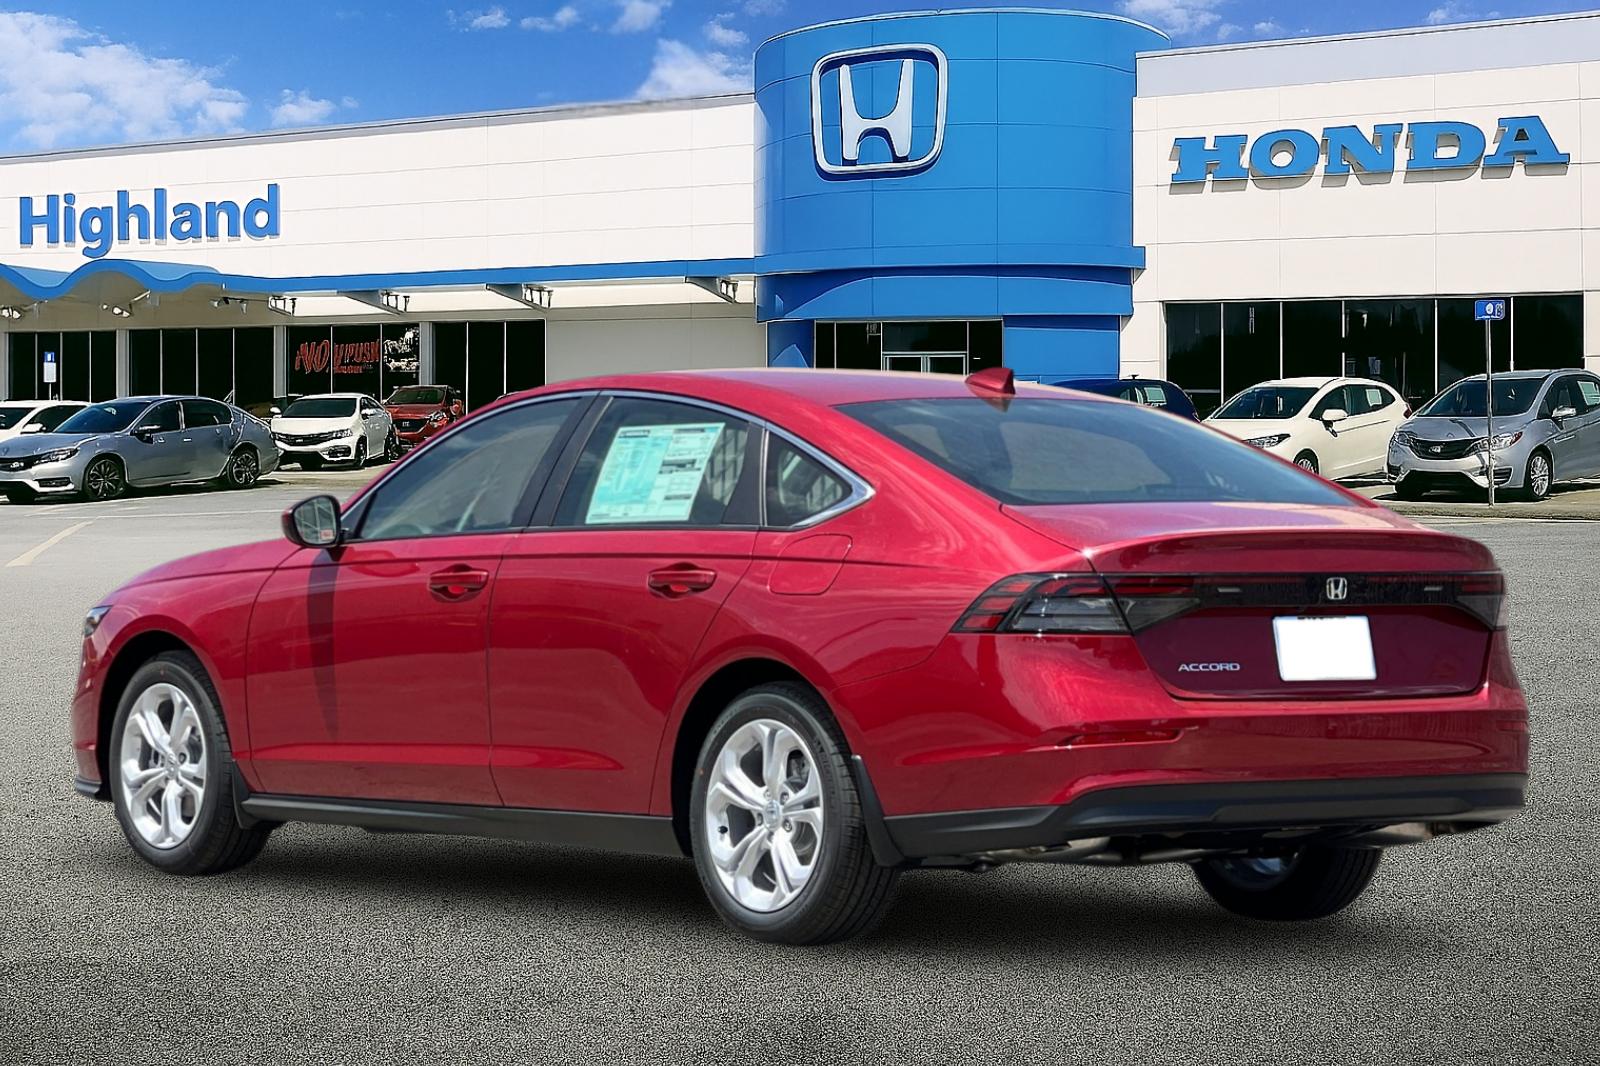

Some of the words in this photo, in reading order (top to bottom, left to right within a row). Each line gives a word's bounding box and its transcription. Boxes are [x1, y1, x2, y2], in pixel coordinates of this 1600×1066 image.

[1170, 114, 1570, 188] HONDA
[19, 183, 281, 258] Highland
[1178, 663, 1240, 672] ACCORD
